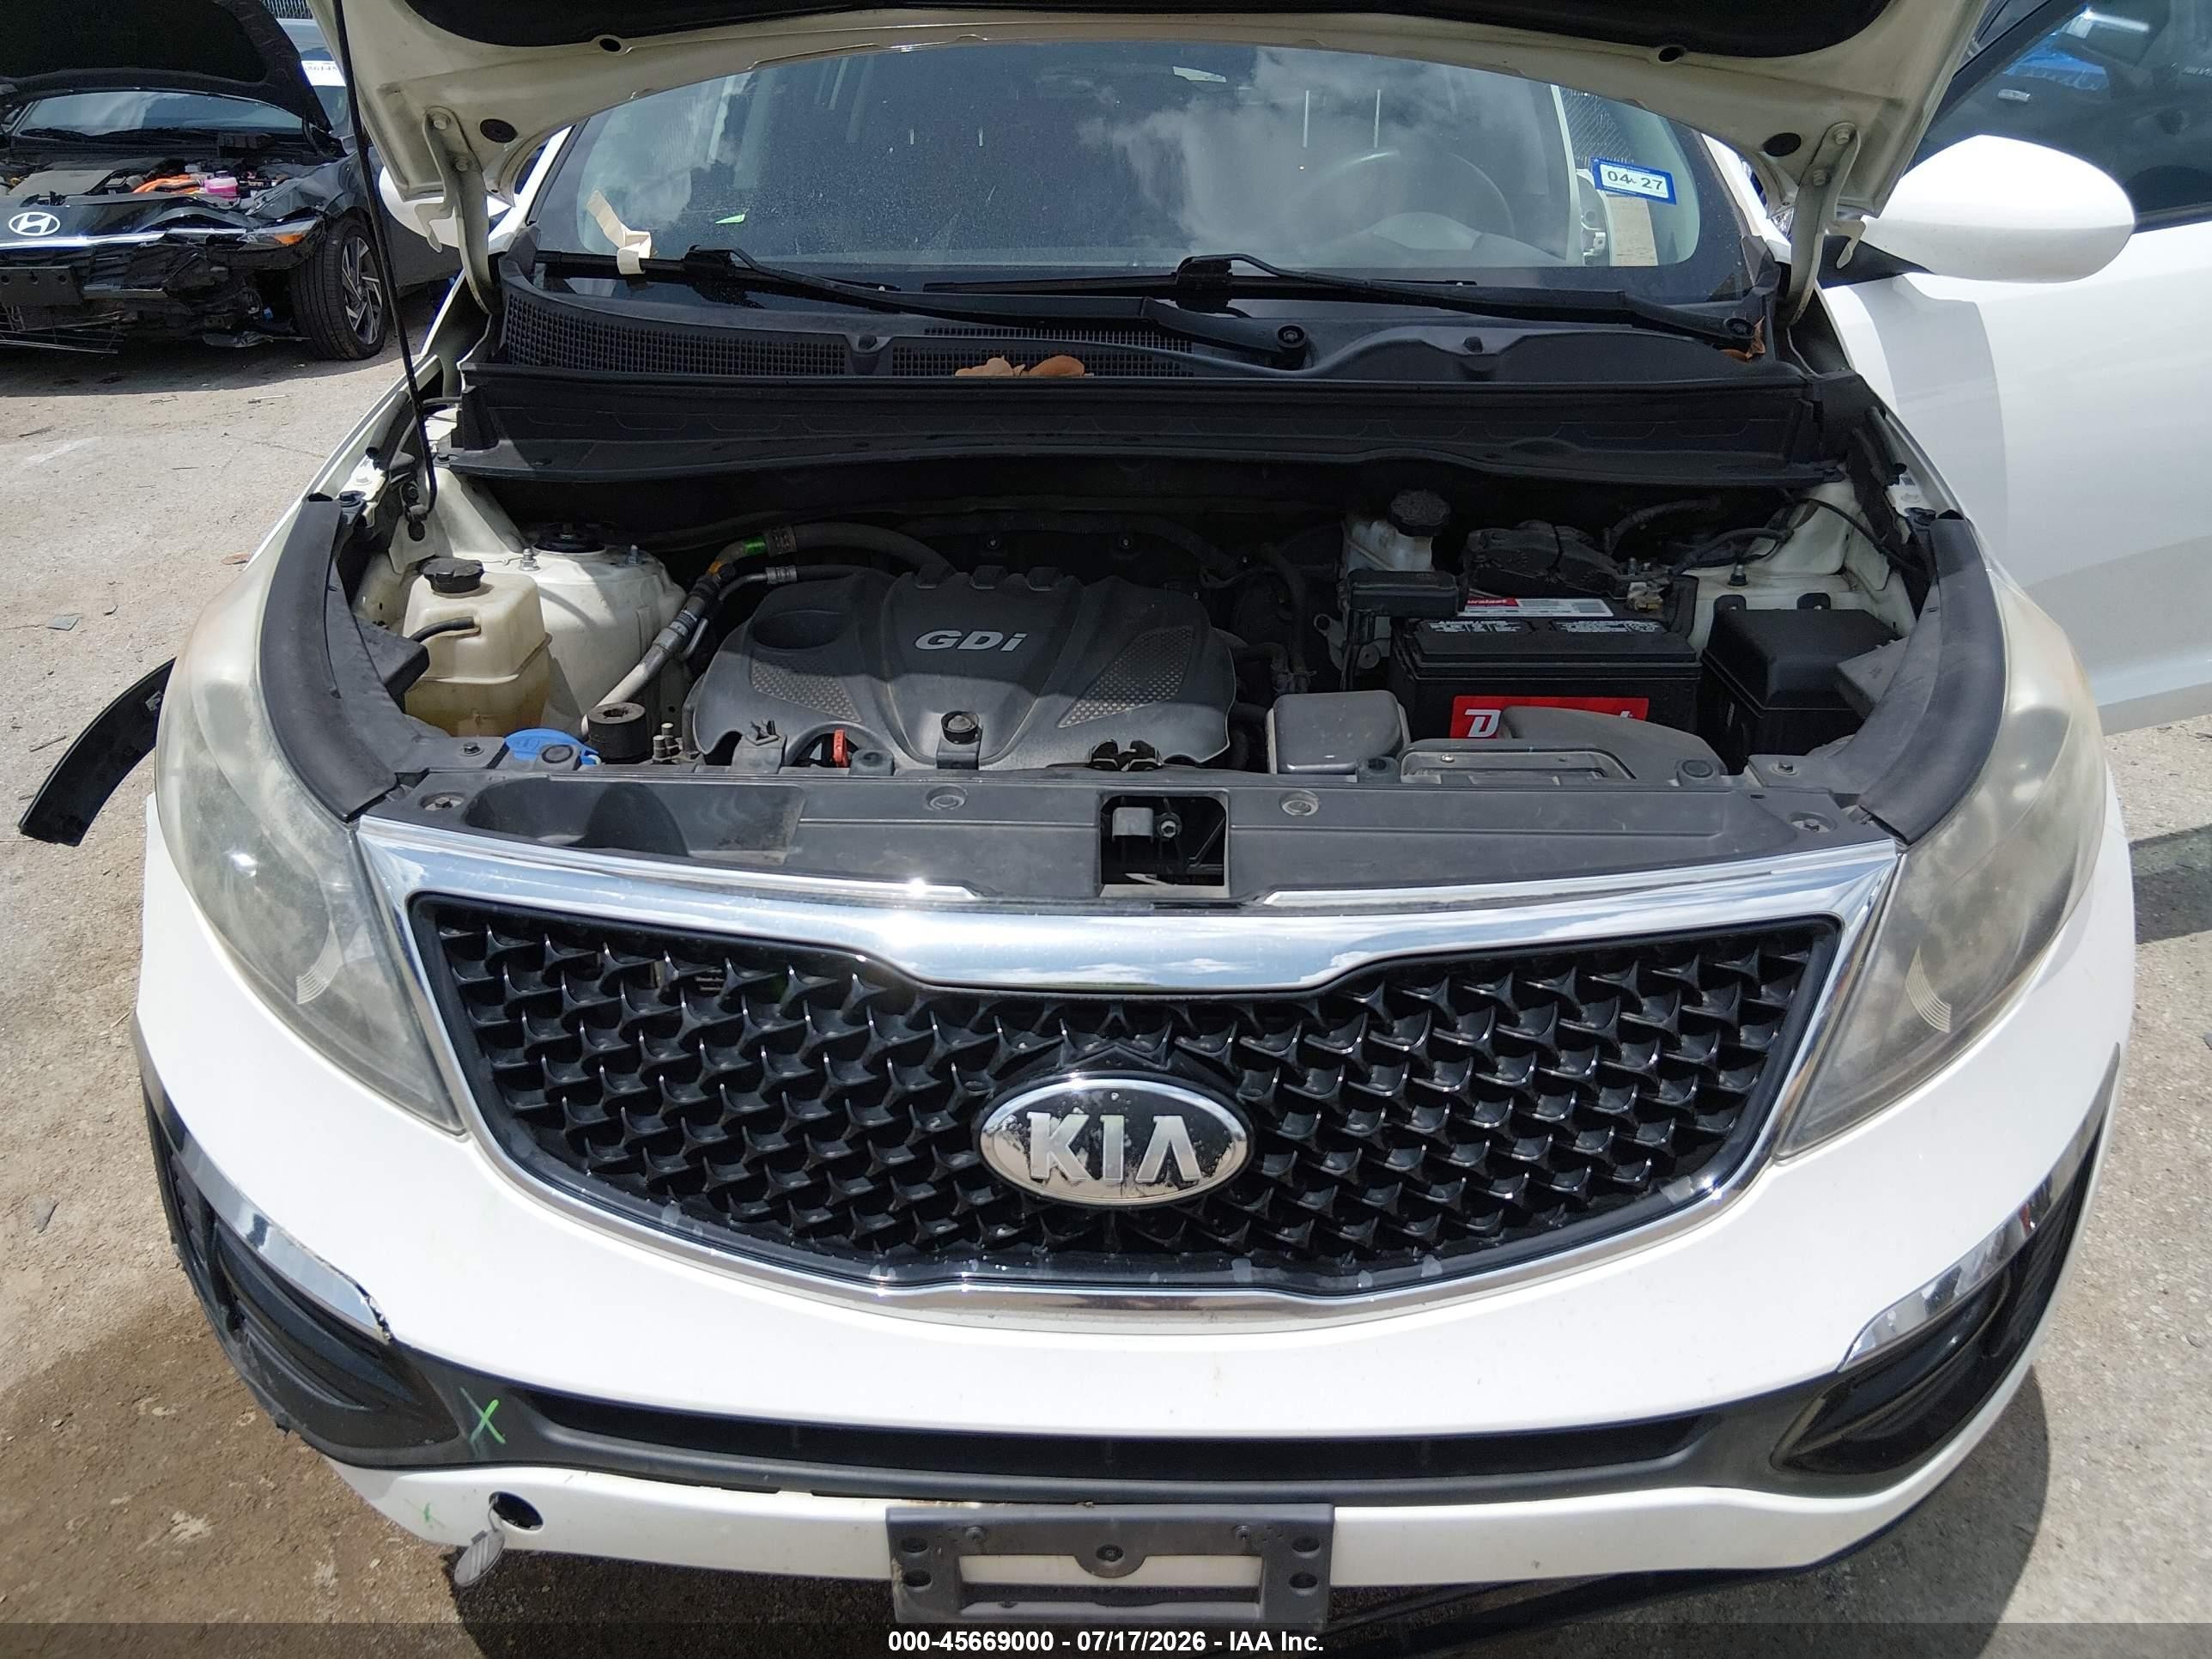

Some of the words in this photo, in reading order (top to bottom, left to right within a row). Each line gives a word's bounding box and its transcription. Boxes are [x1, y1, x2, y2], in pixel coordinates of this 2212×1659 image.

[1607, 171, 1631, 185] 04
[1640, 177, 1662, 191] 27
[915, 629, 1028, 652] GDi
[1027, 1112, 1202, 1183] KIA
